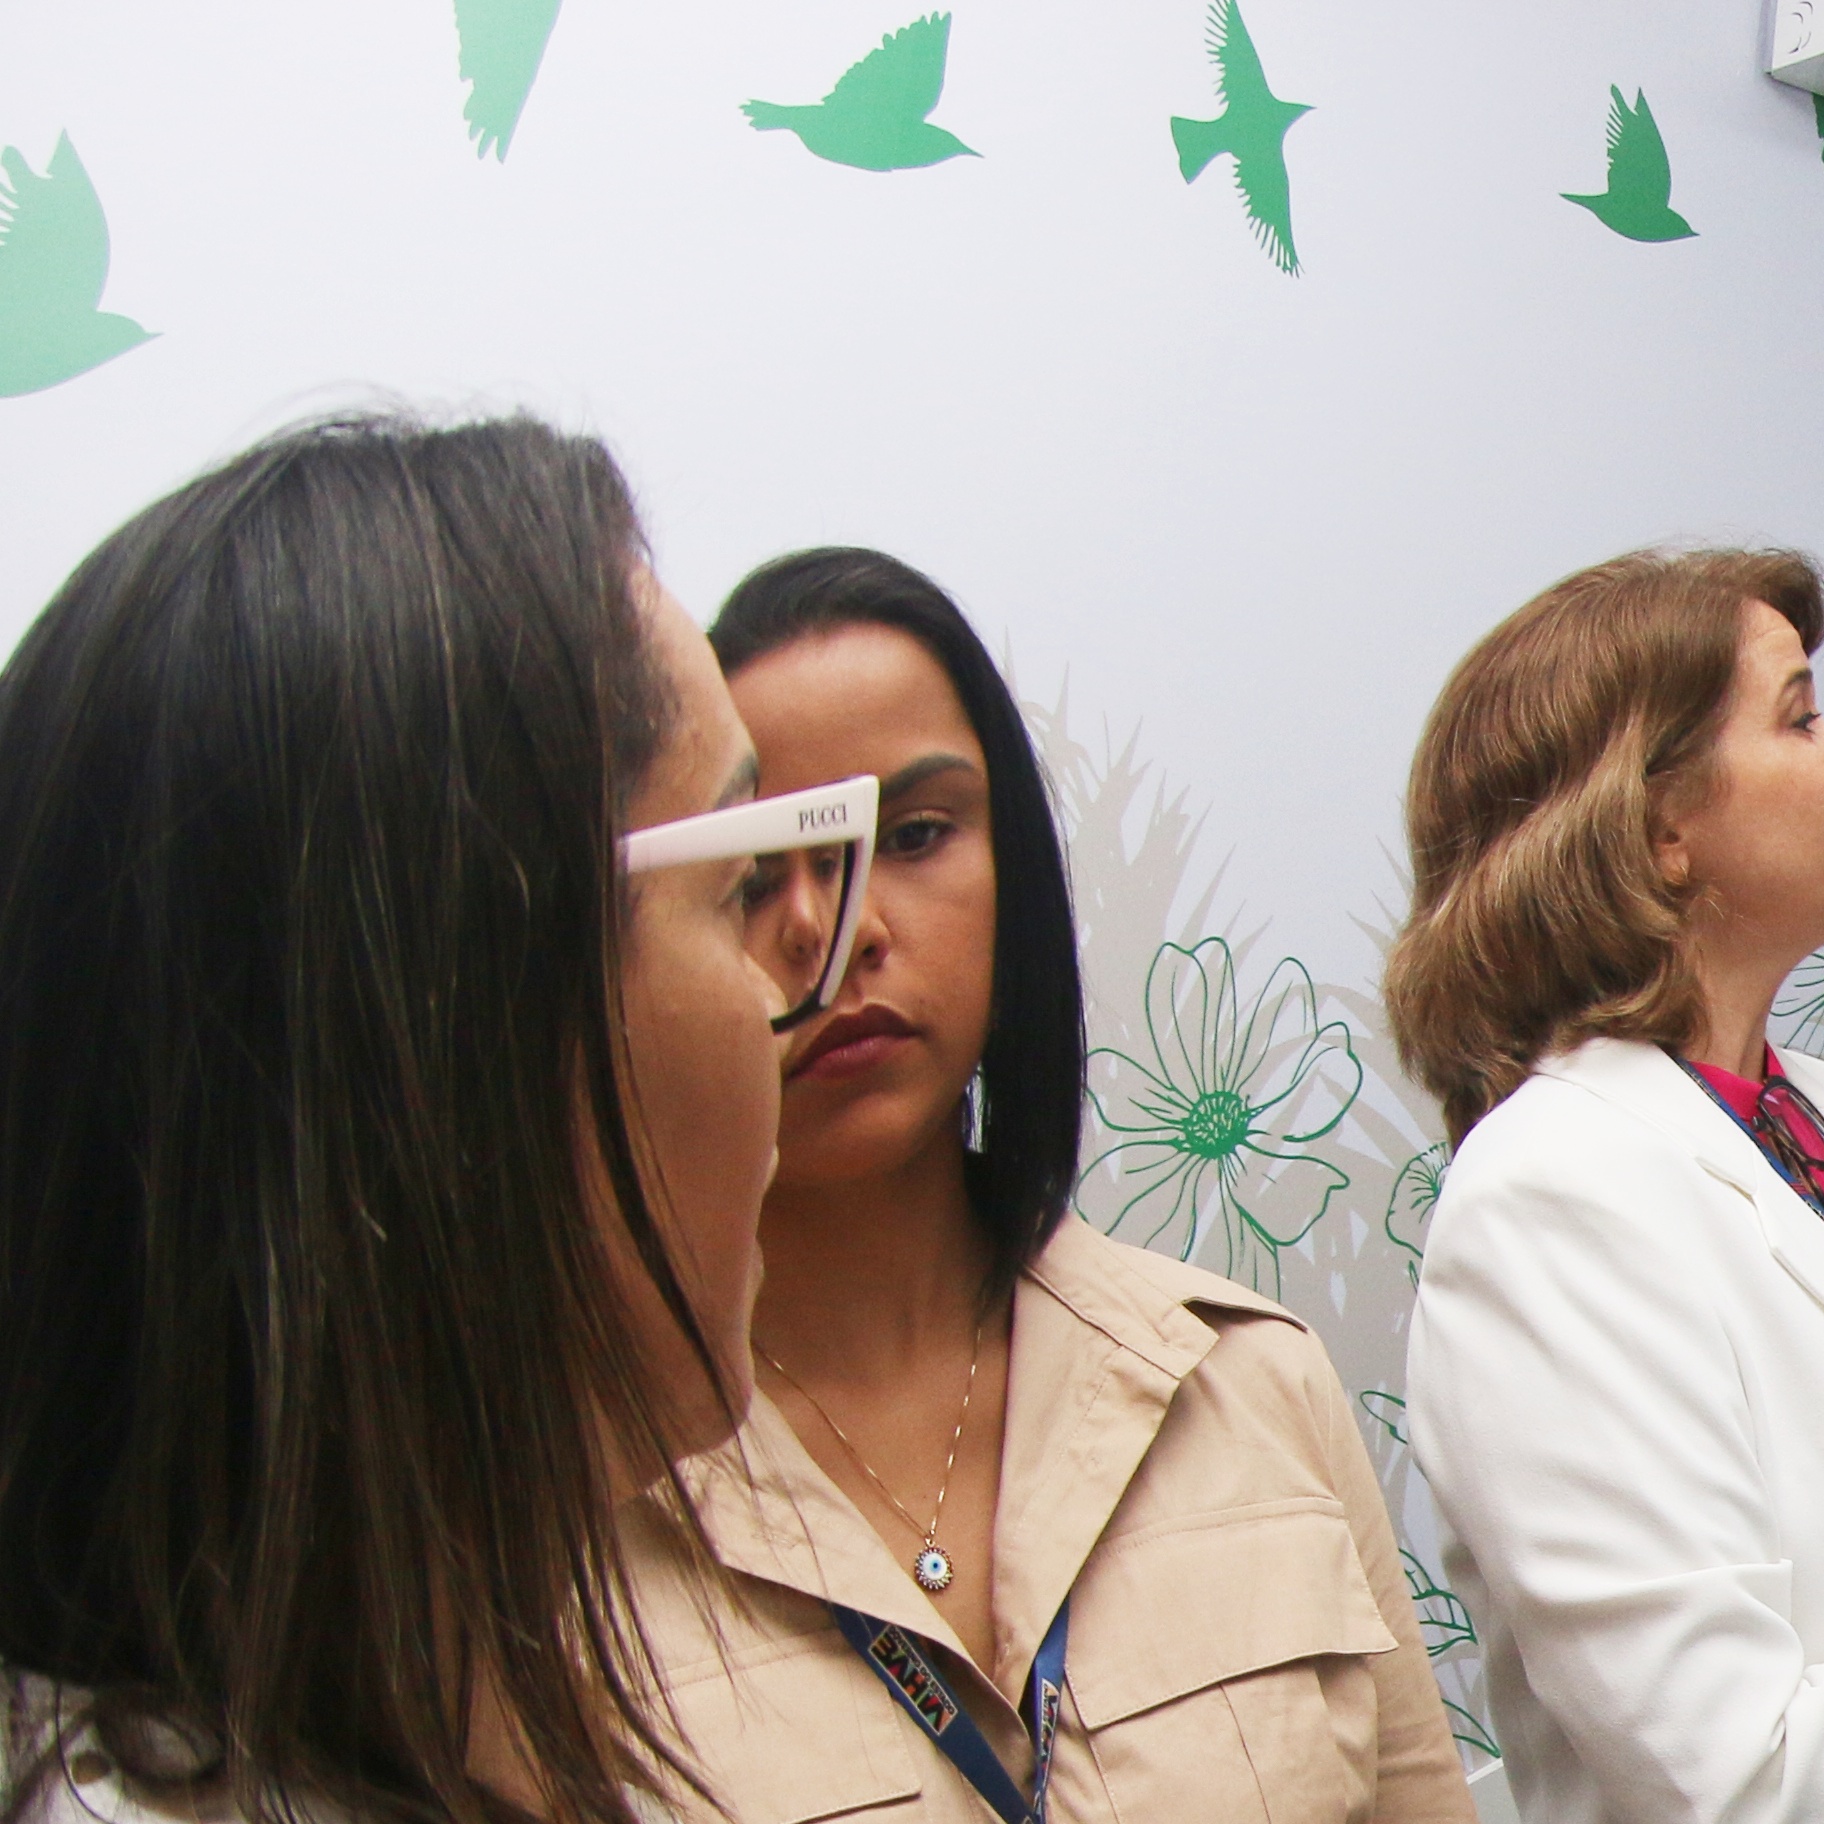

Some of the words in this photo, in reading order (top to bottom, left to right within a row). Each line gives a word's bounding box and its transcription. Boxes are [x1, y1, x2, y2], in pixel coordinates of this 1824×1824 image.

[798, 802, 848, 832] PUCCI
[869, 1632, 951, 1733] BAHIA
[889, 1626, 922, 1669] GOVERNO
[929, 1681, 956, 1716] ESTADO
